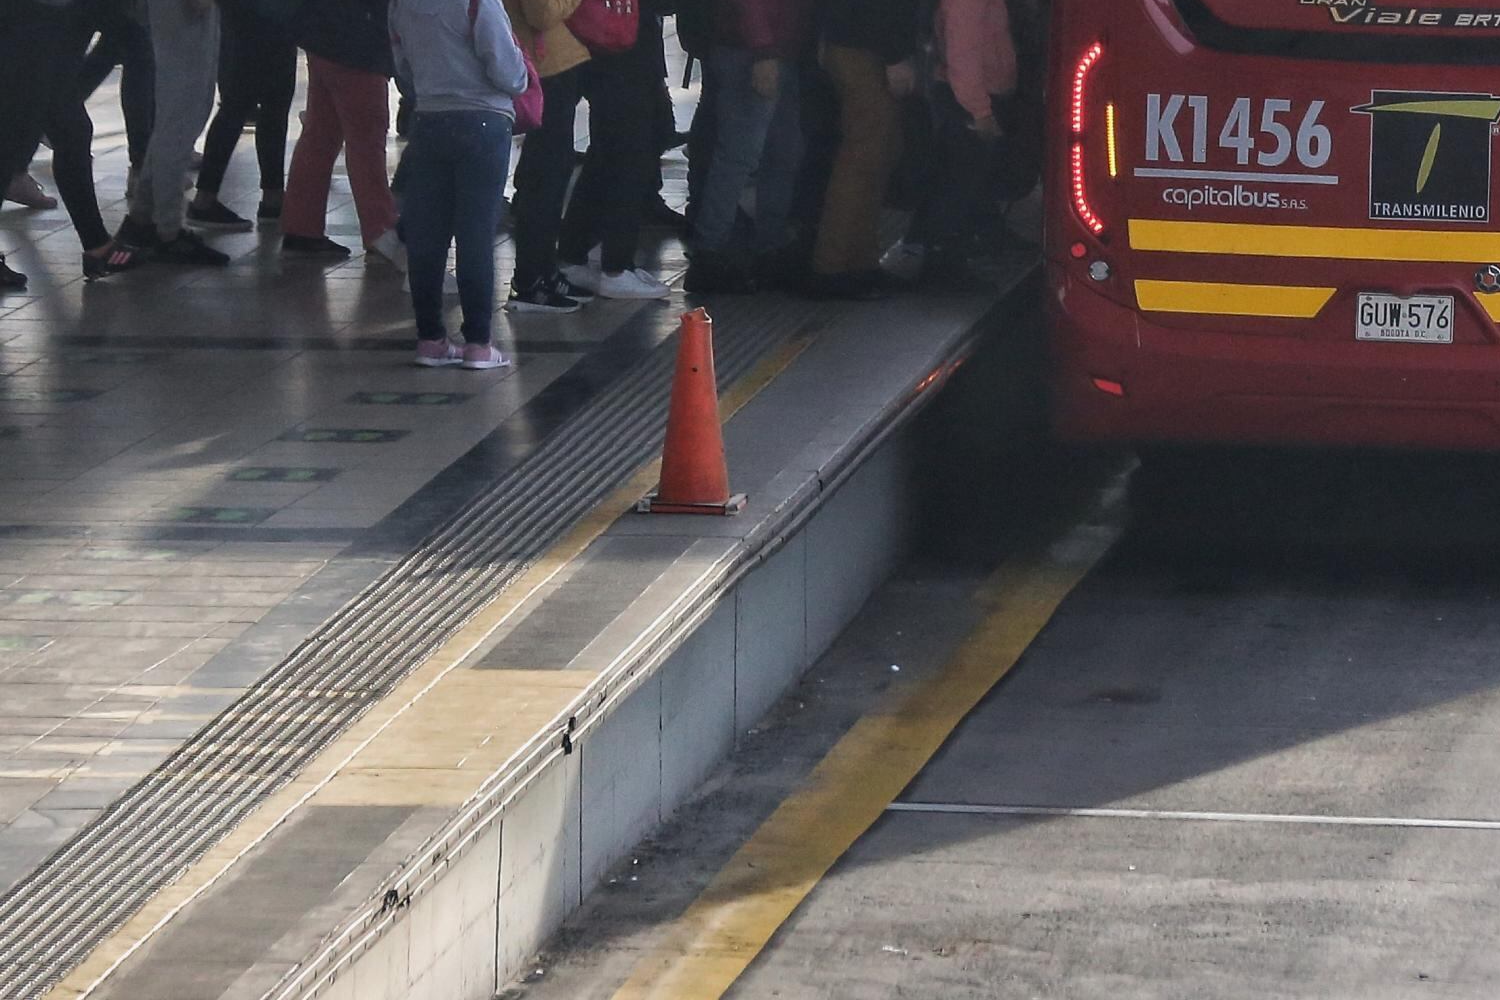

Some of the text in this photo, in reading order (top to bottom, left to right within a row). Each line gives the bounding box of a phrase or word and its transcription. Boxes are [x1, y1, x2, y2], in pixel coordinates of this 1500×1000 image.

[1329, 6, 1443, 26] Viale
[1145, 93, 1332, 169] K1456
[1162, 184, 1281, 210] capitalbus
[1373, 202, 1487, 219] TRANSMILENIO
